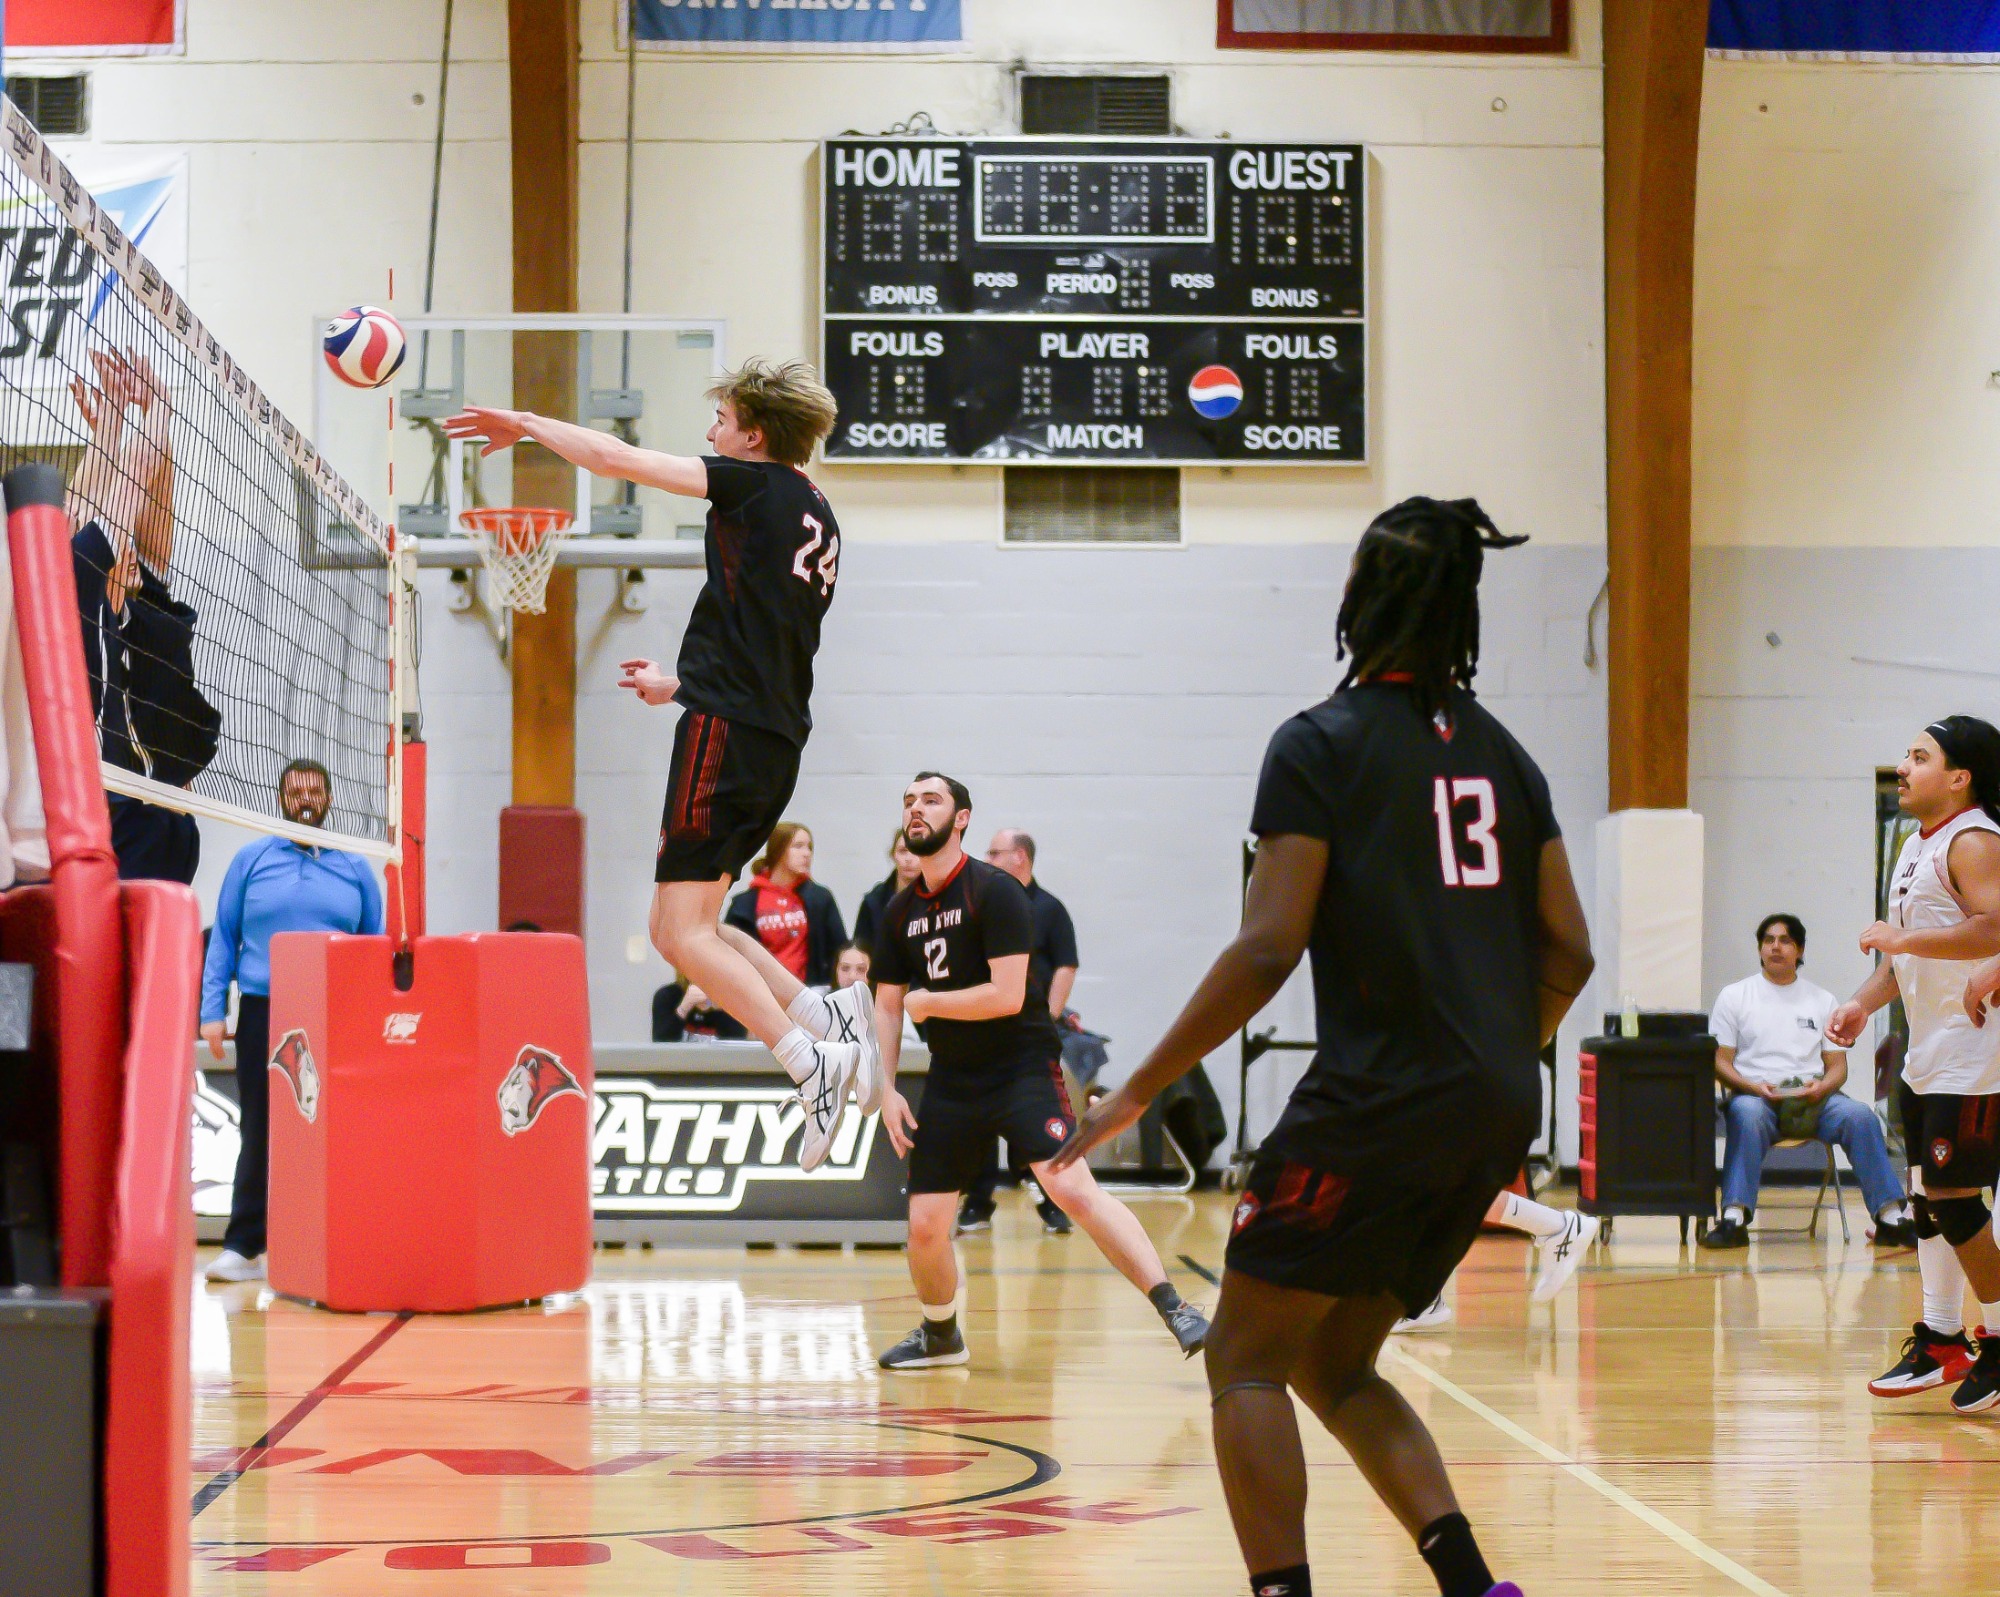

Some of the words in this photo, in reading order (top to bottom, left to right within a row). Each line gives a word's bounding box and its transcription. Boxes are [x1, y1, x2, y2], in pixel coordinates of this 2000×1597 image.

[835, 148, 961, 188] HOME
[1229, 151, 1353, 191] GUEST
[973, 272, 1018, 288] POSS
[1046, 273, 1118, 294] PERIOD
[1170, 274, 1215, 289] POSS
[869, 285, 938, 306] BONUS
[1251, 288, 1319, 308] BONUS
[850, 332, 944, 357] FOULS
[1040, 333, 1150, 359] PLAYER
[1245, 335, 1338, 360] FOULS
[848, 423, 947, 448] SCORE
[1046, 425, 1144, 449] MATCH
[1243, 426, 1341, 451] SCORE
[1433, 776, 1501, 887] 13
[923, 937, 950, 981] 12
